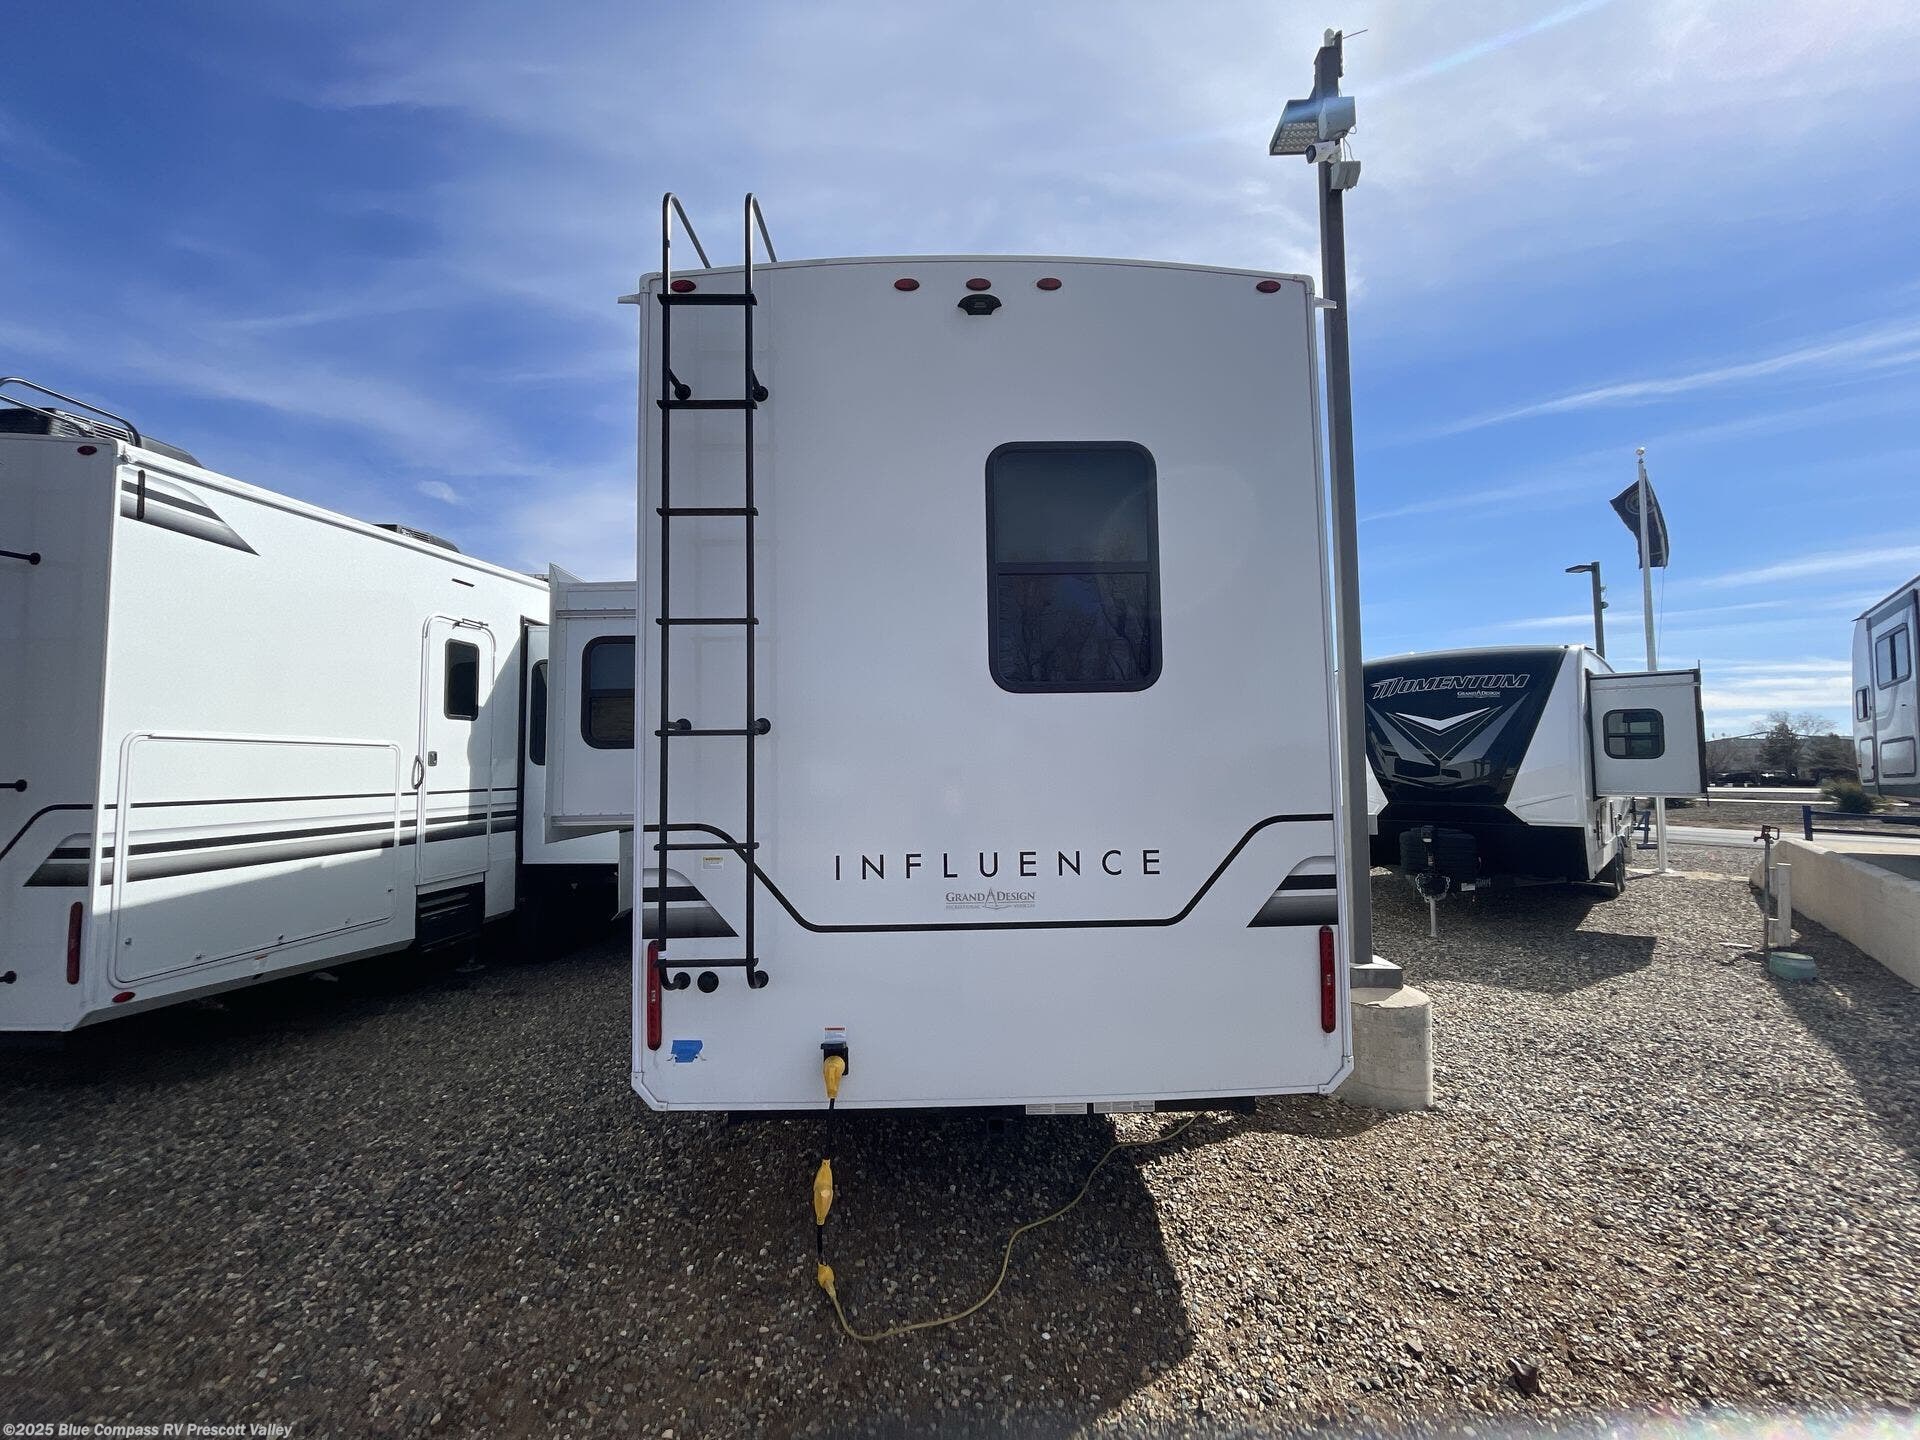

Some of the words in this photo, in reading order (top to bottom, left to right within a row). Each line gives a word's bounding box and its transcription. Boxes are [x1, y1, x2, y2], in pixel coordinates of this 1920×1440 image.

[1370, 674, 1530, 699] MOMENTUM
[835, 850, 1160, 880] INFLUENCE
[945, 892, 985, 902] GRAND
[996, 890, 1036, 901] DESIGN
